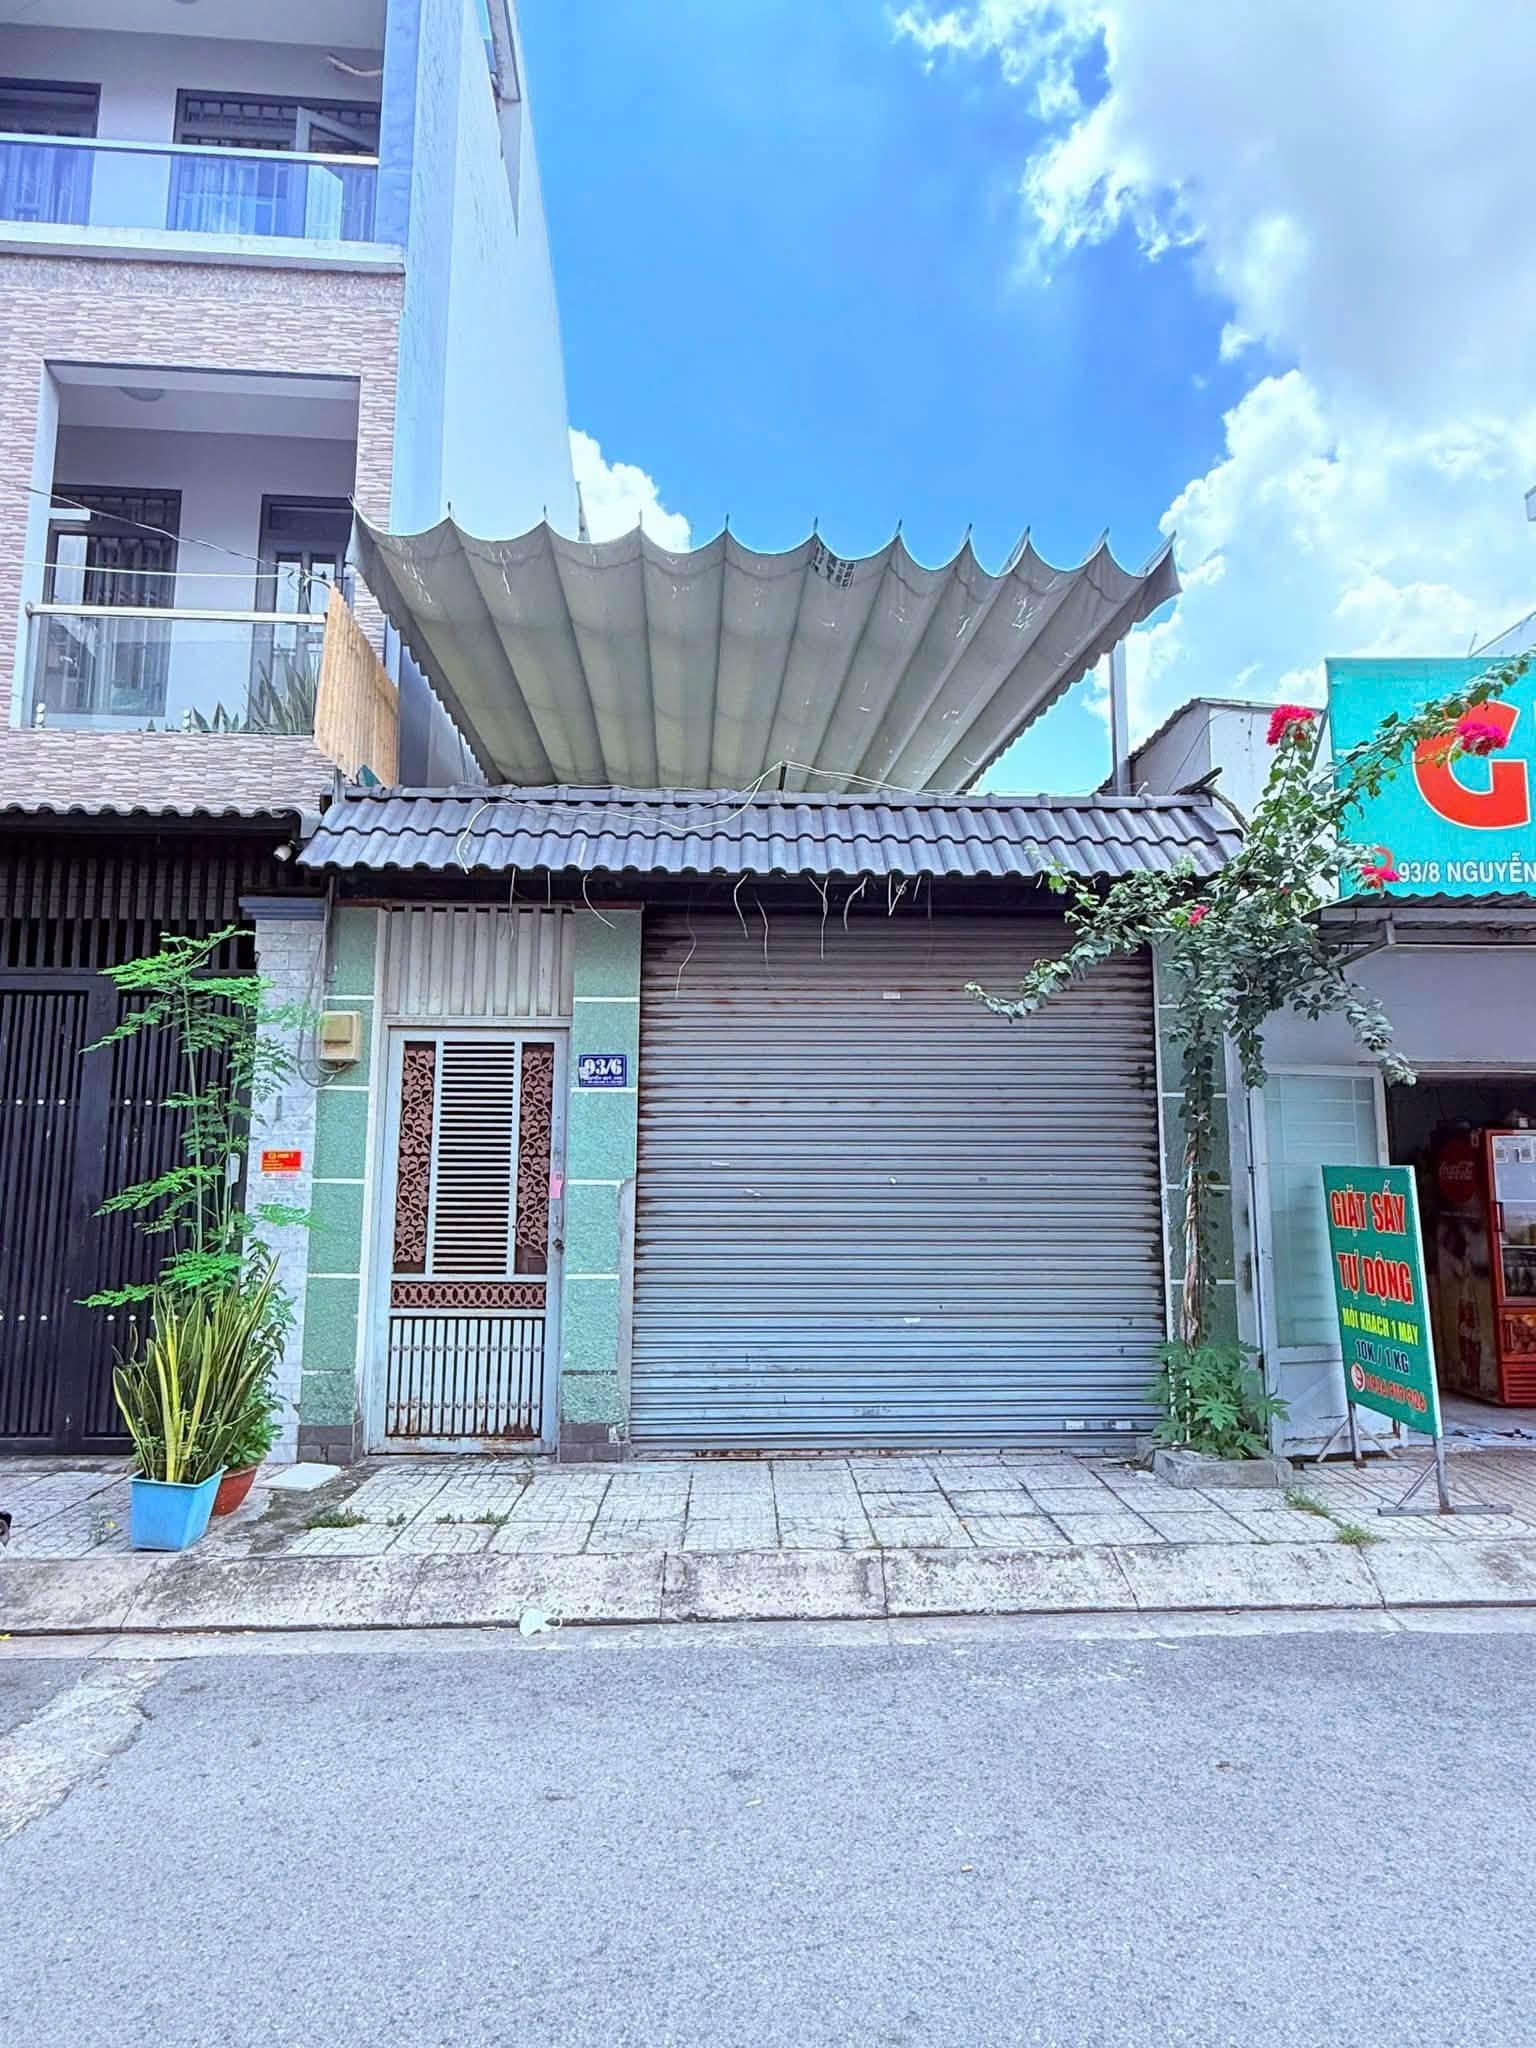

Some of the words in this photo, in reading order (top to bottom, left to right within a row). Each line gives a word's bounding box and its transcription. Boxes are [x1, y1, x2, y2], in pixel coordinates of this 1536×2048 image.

[1399, 861, 1440, 883] 93/8
[1447, 852, 1536, 883] NGUYỄN
[583, 1058, 622, 1075] 93/6
[1329, 1184, 1367, 1237] GIẶT
[1370, 1180, 1406, 1235] SẤY
[1336, 1249, 1360, 1300] TỰ
[1391, 1320, 1397, 1340] 1
